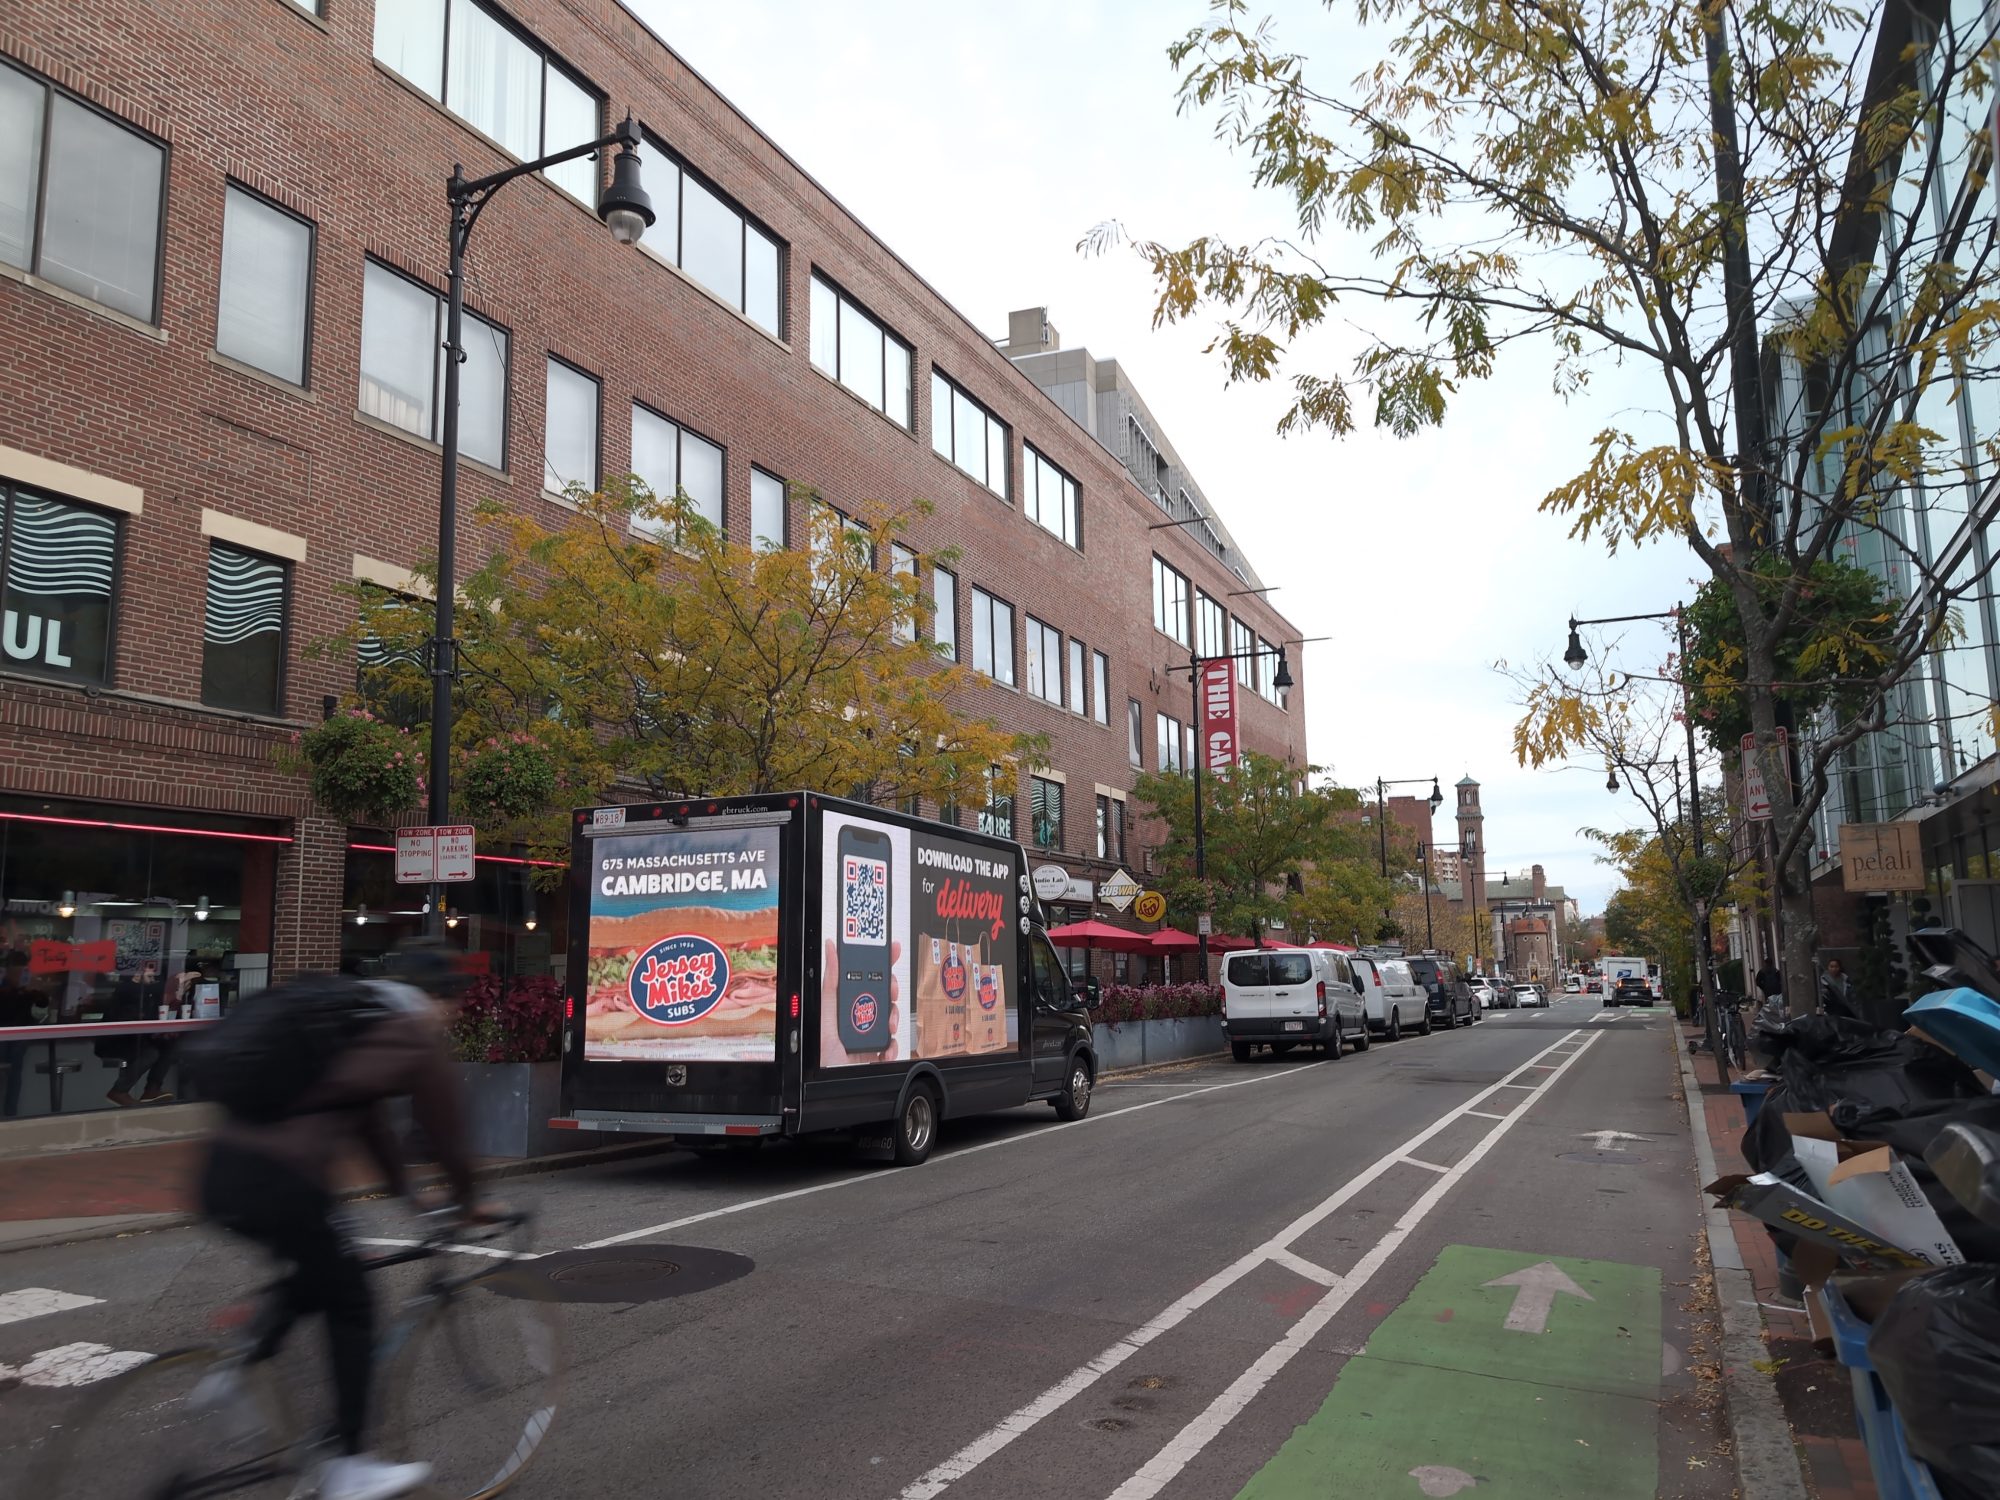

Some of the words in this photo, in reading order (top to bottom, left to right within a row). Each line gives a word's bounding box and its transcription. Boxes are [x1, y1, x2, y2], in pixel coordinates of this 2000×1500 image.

[1207, 664, 1230, 719] THE
[416, 828, 432, 836] ZONE
[410, 839, 421, 847] NO
[442, 844, 468, 852] PARKING
[400, 850, 432, 858] STOPPING
[602, 859, 623, 870] 675
[627, 852, 735, 869] MASSACHUSETTS
[739, 850, 766, 863] AVE
[917, 847, 973, 873] DOWNLOAD
[974, 859, 991, 876] THE
[992, 863, 1009, 880] APP
[601, 870, 728, 896] CAMBRIDGE,
[731, 868, 767, 890] MA
[1098, 884, 1142, 897] SUBWAY
[922, 877, 935, 894] for
[937, 878, 1005, 940] delivery
[659, 943, 677, 954] SINCE
[640, 952, 716, 982] Jersey
[646, 974, 717, 1009] Mike's
[667, 1004, 696, 1018] SUBS
[1780, 1207, 1828, 1231] DO
[1828, 1226, 1881, 1249] THE
